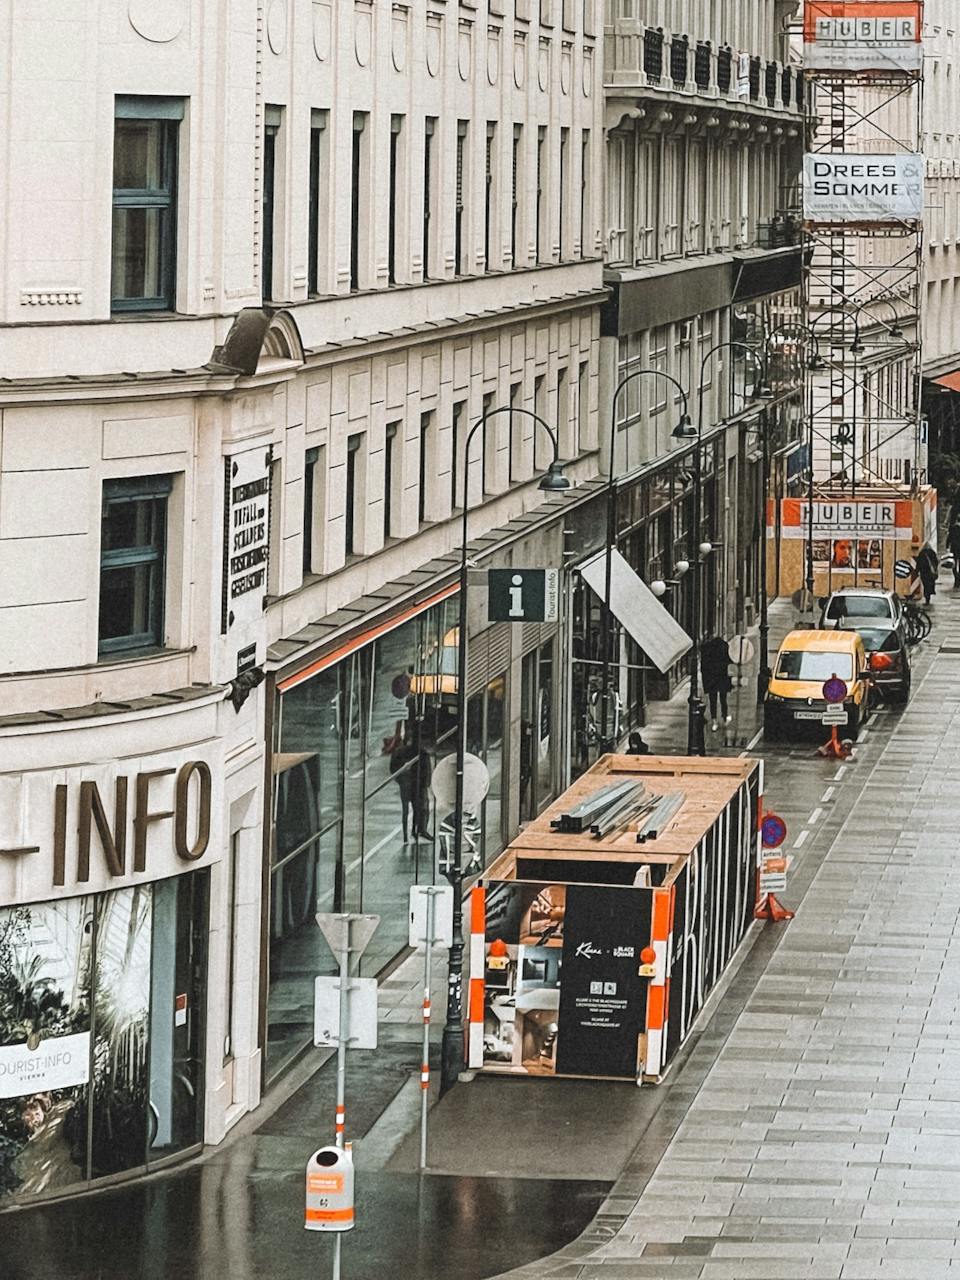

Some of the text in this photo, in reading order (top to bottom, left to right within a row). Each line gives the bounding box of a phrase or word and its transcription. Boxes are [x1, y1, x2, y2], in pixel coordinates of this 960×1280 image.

[820, 21, 912, 36] HUBER
[814, 163, 920, 178] DREES &
[814, 181, 920, 195] SOMMER
[803, 506, 892, 520] HUBER
[547, 572, 557, 619] Tourist-Info
